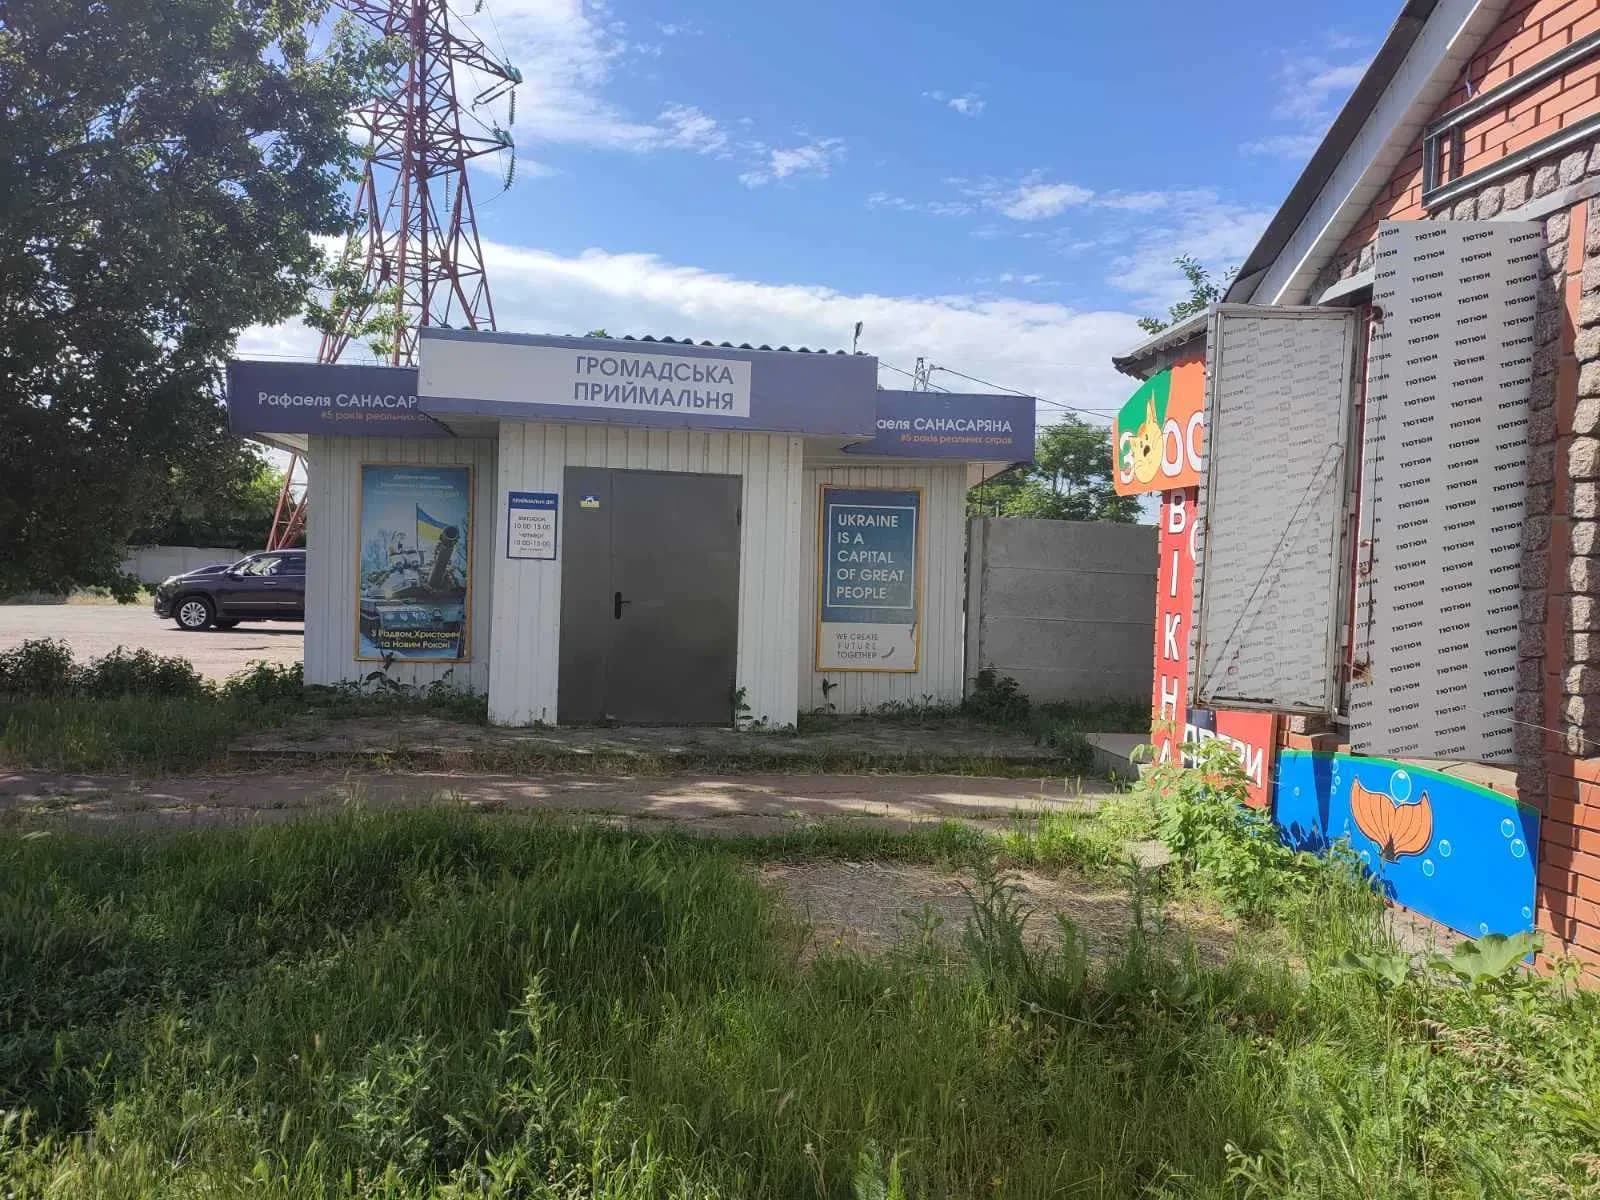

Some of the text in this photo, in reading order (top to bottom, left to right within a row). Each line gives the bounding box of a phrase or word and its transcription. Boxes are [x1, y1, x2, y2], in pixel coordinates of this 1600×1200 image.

[576, 355, 734, 385] ГРОМАДСЬКА
[258, 391, 417, 409] Рафаеля САНАСАР
[574, 380, 734, 411] ПРИЙМАЛЬНЯ
[914, 417, 1013, 433] САНАСАРЯНА
[838, 513, 899, 528] UKRAINE
[837, 531, 865, 545] IS A
[837, 550, 895, 564] CAPITAL
[836, 568, 905, 582] OF GREAT
[836, 586, 887, 599] PEOPLE
[1181, 722, 1264, 789] ДВРИ
